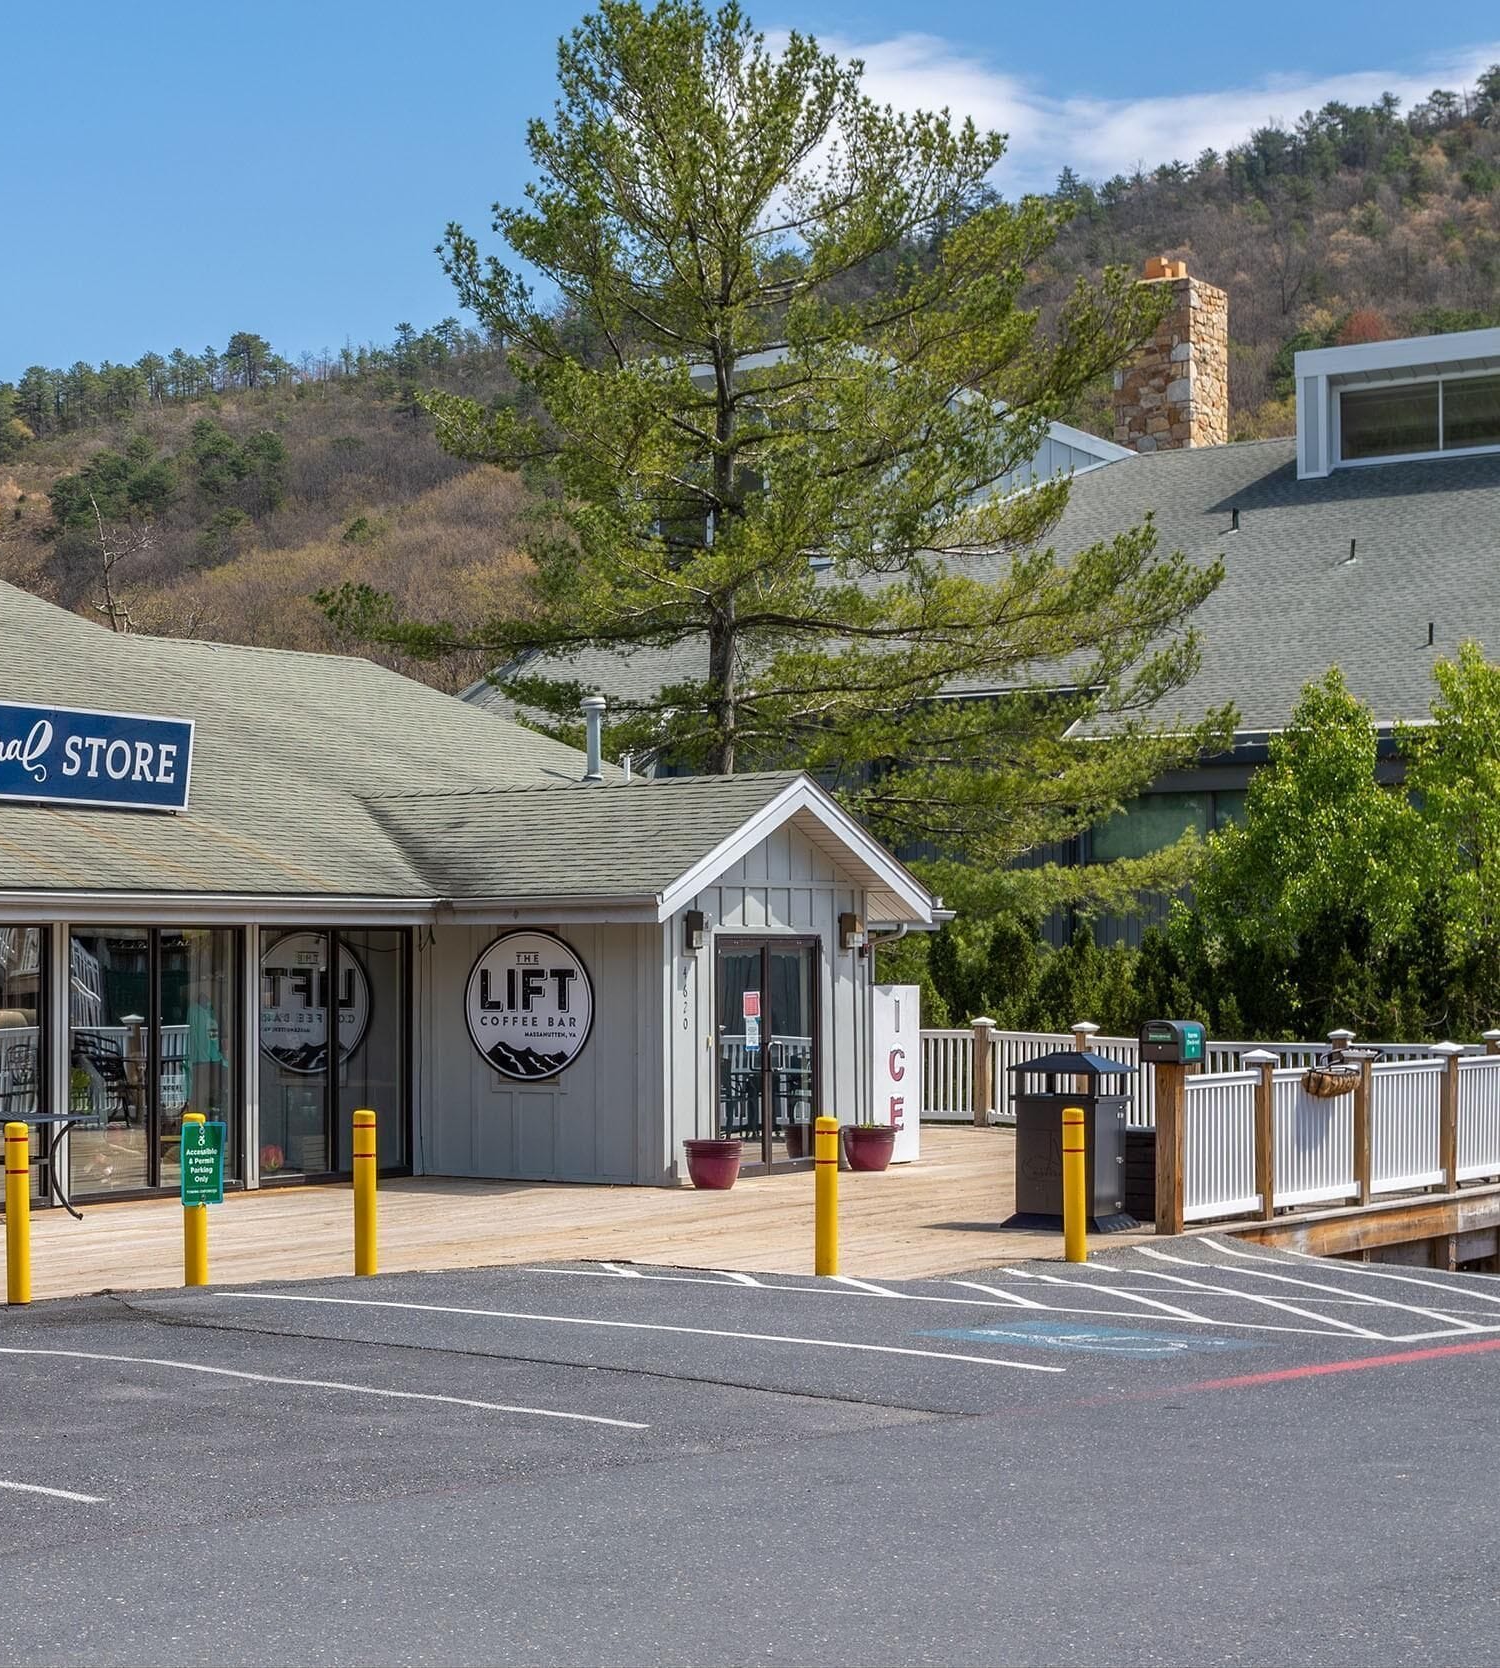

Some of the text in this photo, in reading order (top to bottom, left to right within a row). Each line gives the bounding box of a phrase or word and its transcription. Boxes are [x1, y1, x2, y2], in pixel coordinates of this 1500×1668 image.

[62, 735, 178, 784] STORE
[516, 954, 540, 963] THE
[480, 968, 578, 1014] LIFT
[480, 1016, 577, 1027] COFFEE BAR
[524, 1031, 568, 1039] MASSANUTTEN,
[889, 996, 906, 1131] ICE
[186, 1147, 218, 1156] Accessible
[194, 1157, 214, 1165] Permit
[190, 1166, 213, 1174] Parking
[194, 1175, 209, 1184] Only
